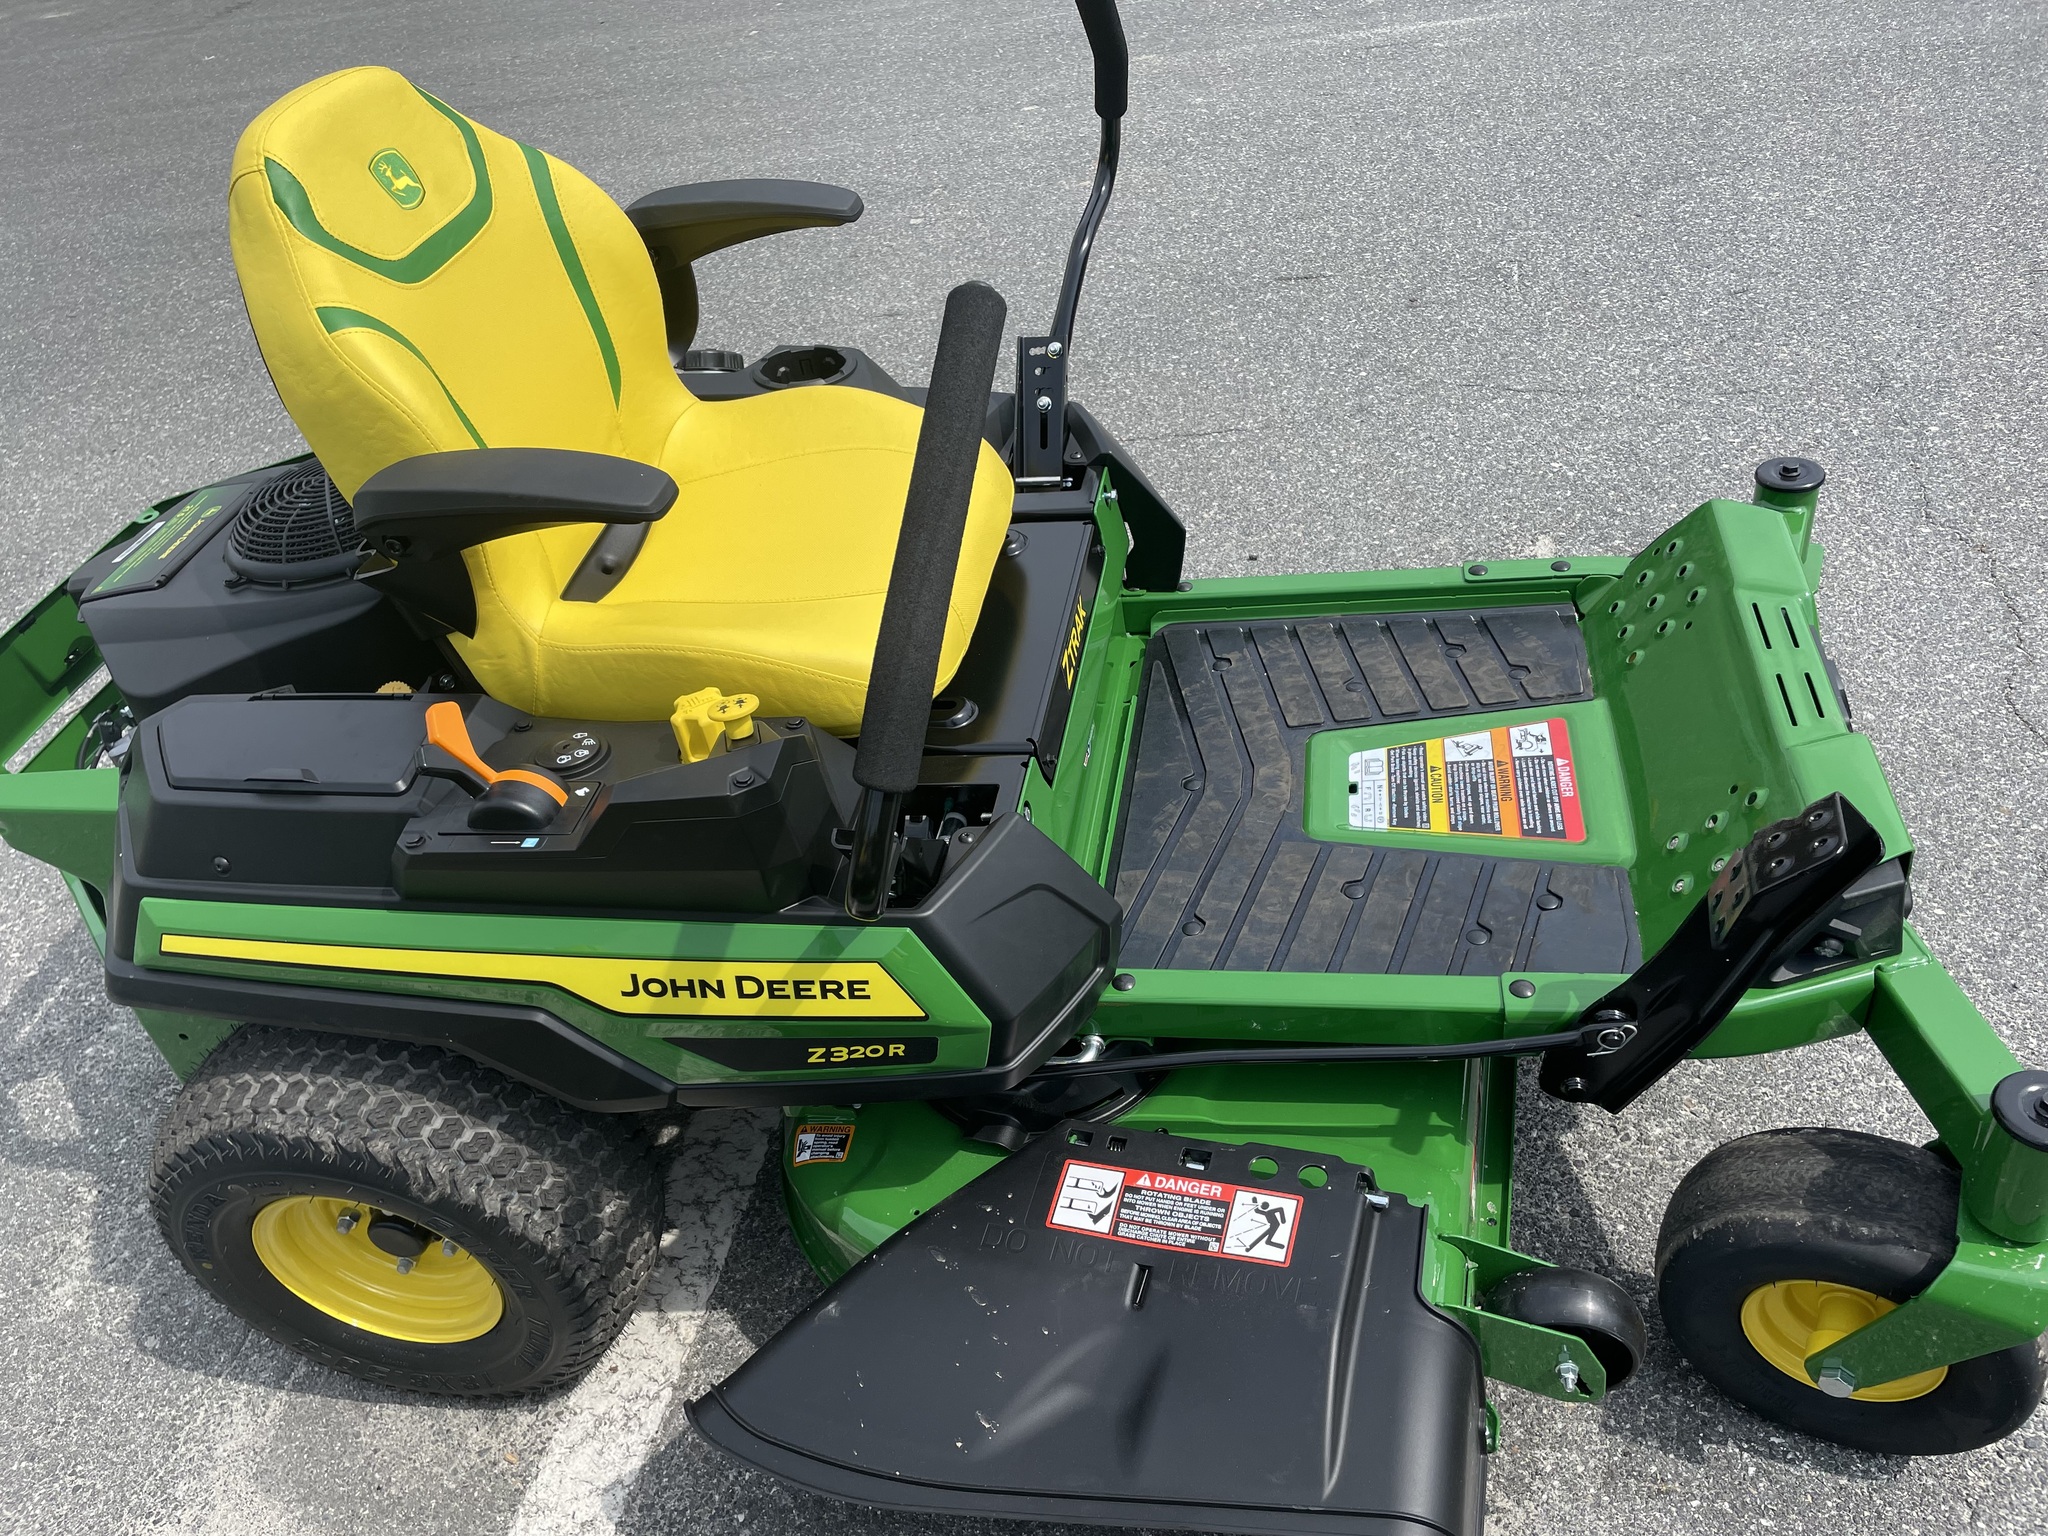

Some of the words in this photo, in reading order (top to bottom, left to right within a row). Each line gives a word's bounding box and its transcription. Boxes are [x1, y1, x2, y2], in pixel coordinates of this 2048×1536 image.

[1062, 594, 1087, 690] ZTRAK
[1430, 773, 1444, 804] CAUTION
[1498, 768, 1512, 802] WARNING
[1558, 764, 1574, 798] DANGER
[621, 973, 726, 999] JOHN
[734, 975, 871, 1000] DEERE
[1154, 1176, 1223, 1198] DANGER
[1140, 1189, 1182, 1201] ROTATING
[1183, 1196, 1211, 1205] BLADE
[1134, 1204, 1170, 1215] THROWN
[1171, 1210, 1210, 1222] OBJECTS
[1136, 1199, 1156, 1207] MOWER
[1173, 1205, 1193, 1213] ENGINE
[1199, 1209, 1224, 1218] RUNNING
[1140, 1211, 1161, 1219] MOWING,
[1161, 1214, 1177, 1222] CLEAR
[1198, 1221, 1221, 1229] OBJECTS
[1152, 1219, 1175, 1227] THROWN
[1117, 1226, 1148, 1236] DISCHARGE
[1136, 1234, 1161, 1242] CATCHER
[1168, 1239, 1185, 1247] PLACE
[1140, 1226, 1167, 1234] OPERATE
[1167, 1230, 1189, 1238] MOWER
[1189, 1234, 1215, 1242] WITHOUT
[981, 1222, 1028, 1254] DO
[1048, 1236, 1116, 1273] NOT
[1167, 1258, 1318, 1304] REMOVE
